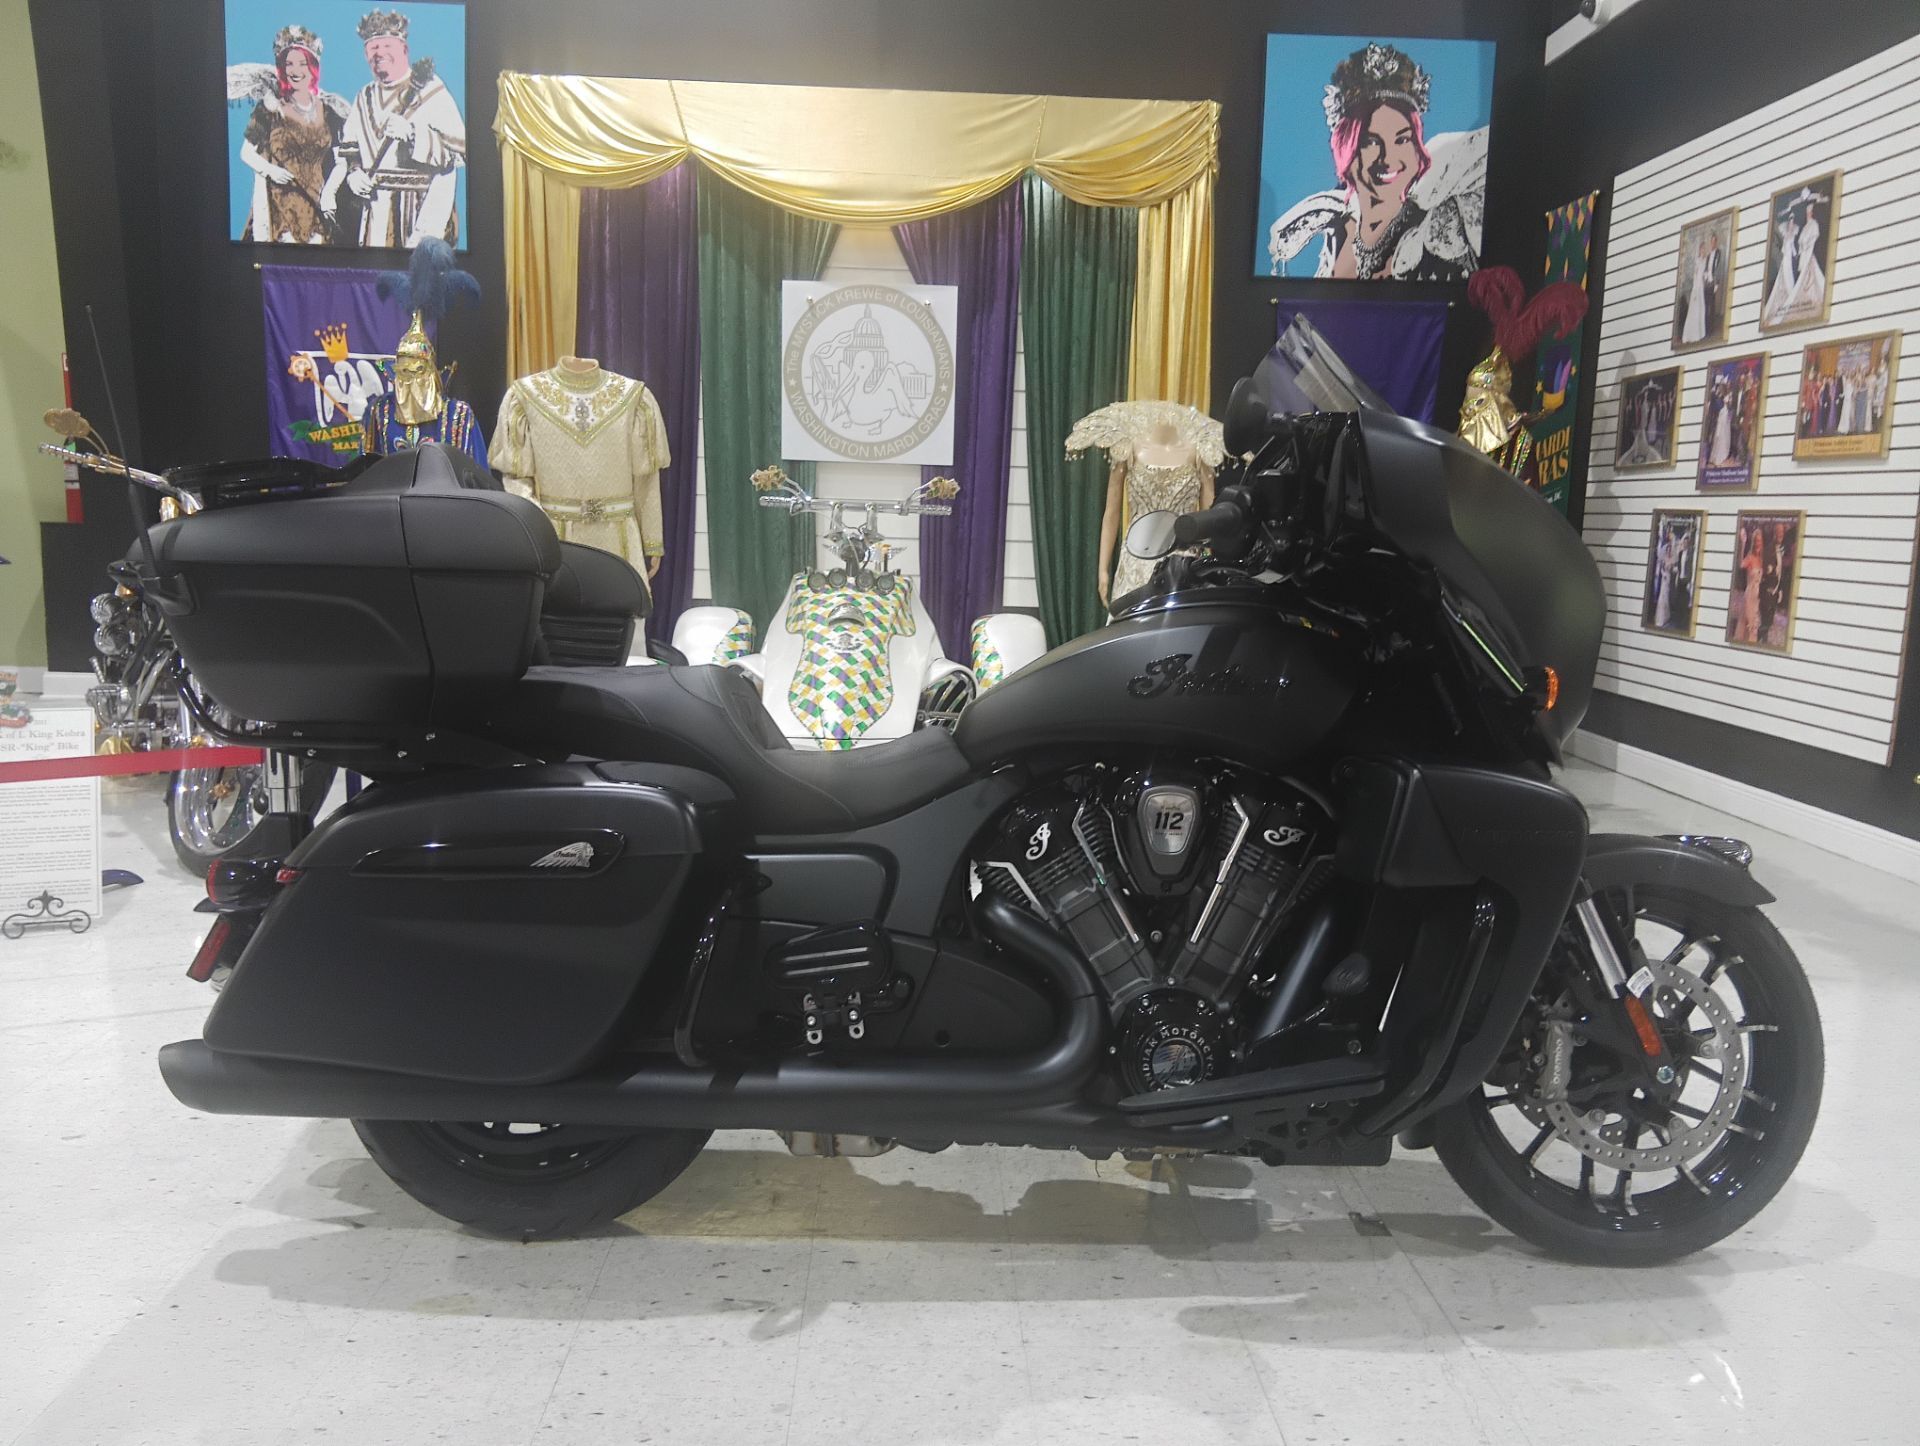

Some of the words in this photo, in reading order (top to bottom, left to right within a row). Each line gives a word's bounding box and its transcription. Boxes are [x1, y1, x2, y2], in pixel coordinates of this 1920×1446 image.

[787, 351, 800, 372] The
[835, 287, 882, 303] KREWE
[886, 293, 898, 304] of
[900, 297, 950, 379] LOUISIANIANS
[791, 392, 872, 456] WASHINGTON
[873, 431, 919, 457] MARDI
[918, 396, 946, 434] GRAS
[1540, 450, 1568, 486] RAS
[29, 730, 53, 739] King
[56, 729, 86, 738] Kobra
[57, 742, 80, 750] Bike
[1155, 812, 1184, 830] 112
